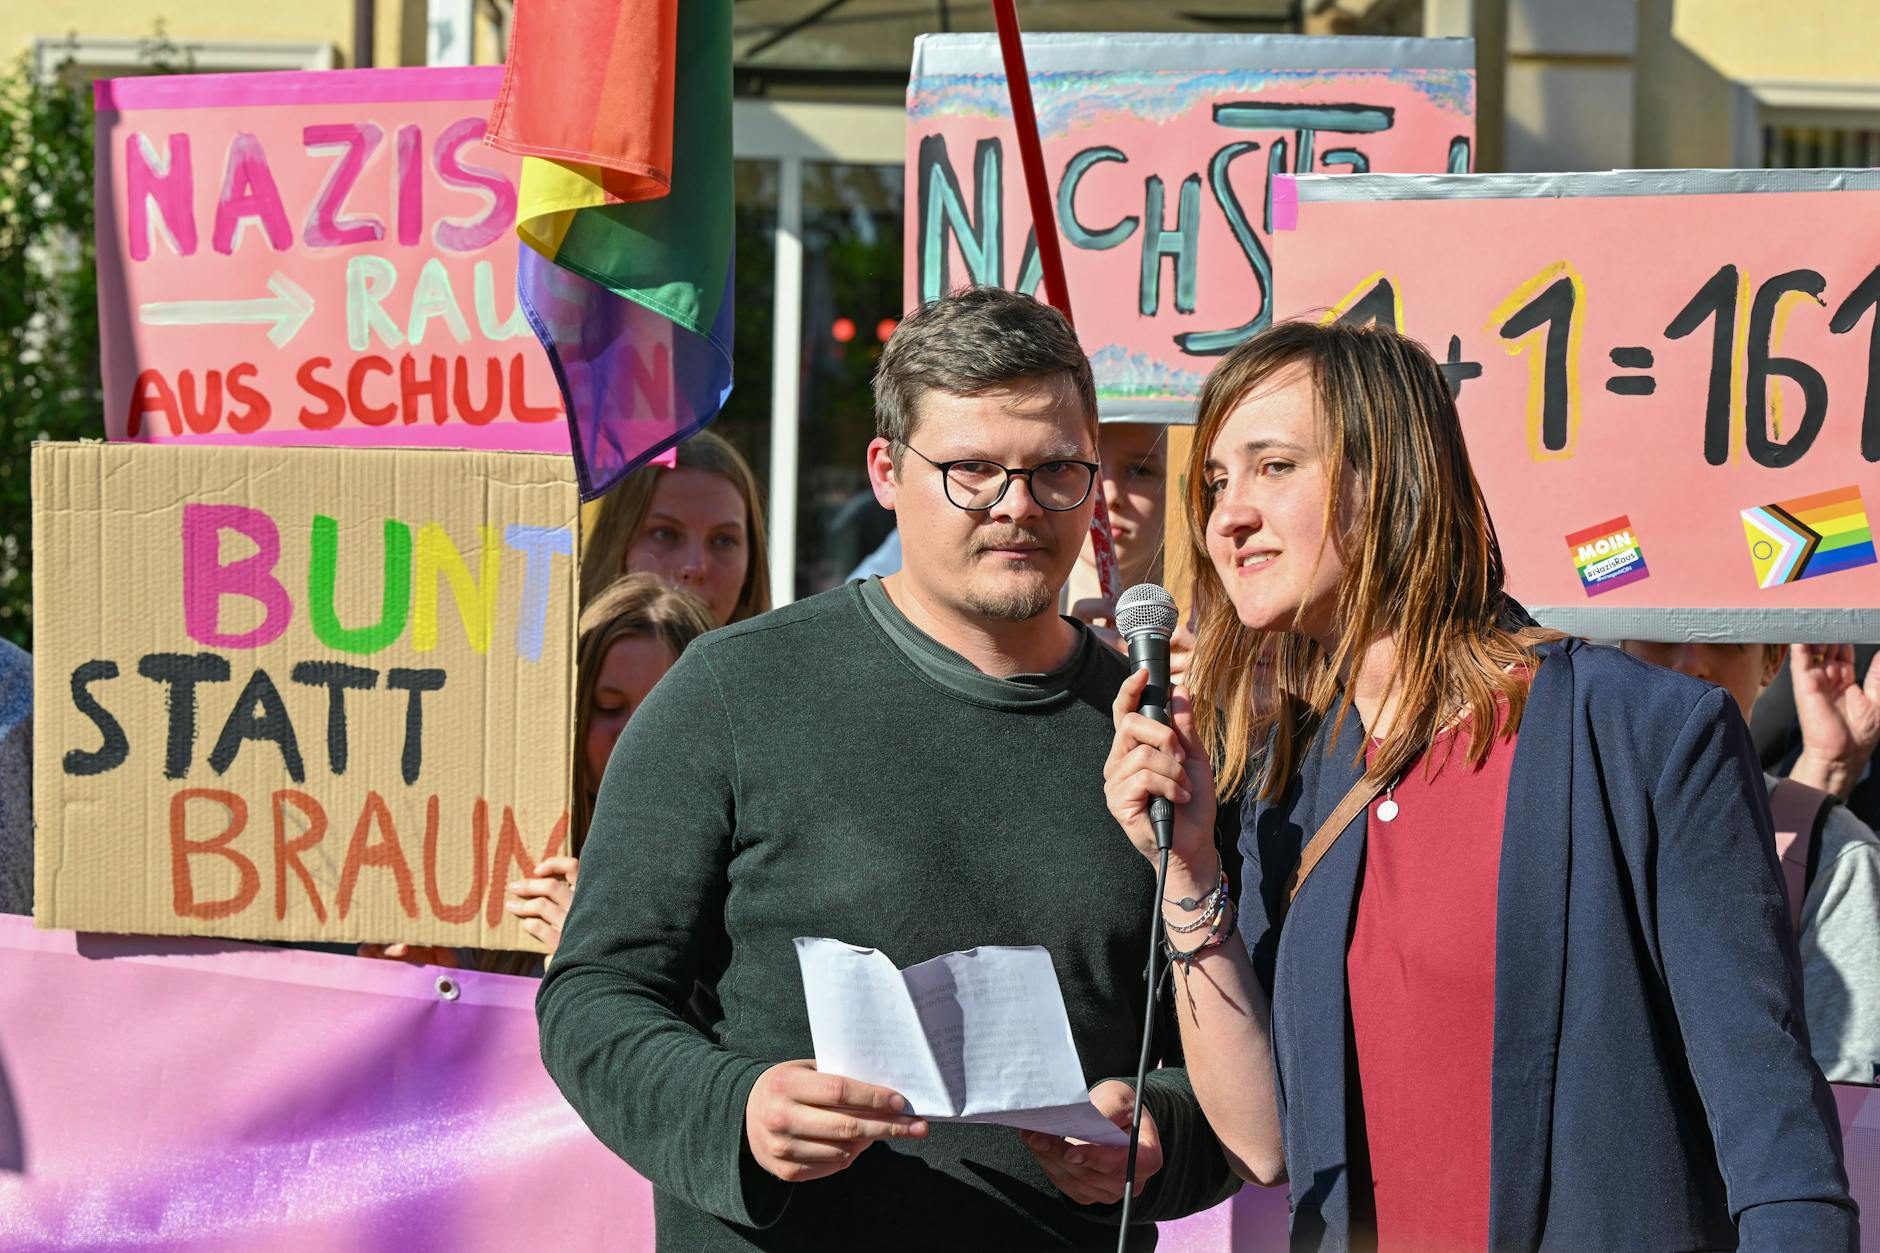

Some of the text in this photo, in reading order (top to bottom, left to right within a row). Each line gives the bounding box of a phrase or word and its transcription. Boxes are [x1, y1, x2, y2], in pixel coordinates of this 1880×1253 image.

[126, 117, 517, 261] NAZIS
[127, 361, 272, 438] AUS
[181, 502, 574, 663] BUNT
[1577, 531, 1632, 562] MOIN
[1586, 552, 1636, 578] #NazisRaus
[62, 652, 447, 785] STATT
[168, 788, 569, 928] BRAUN
